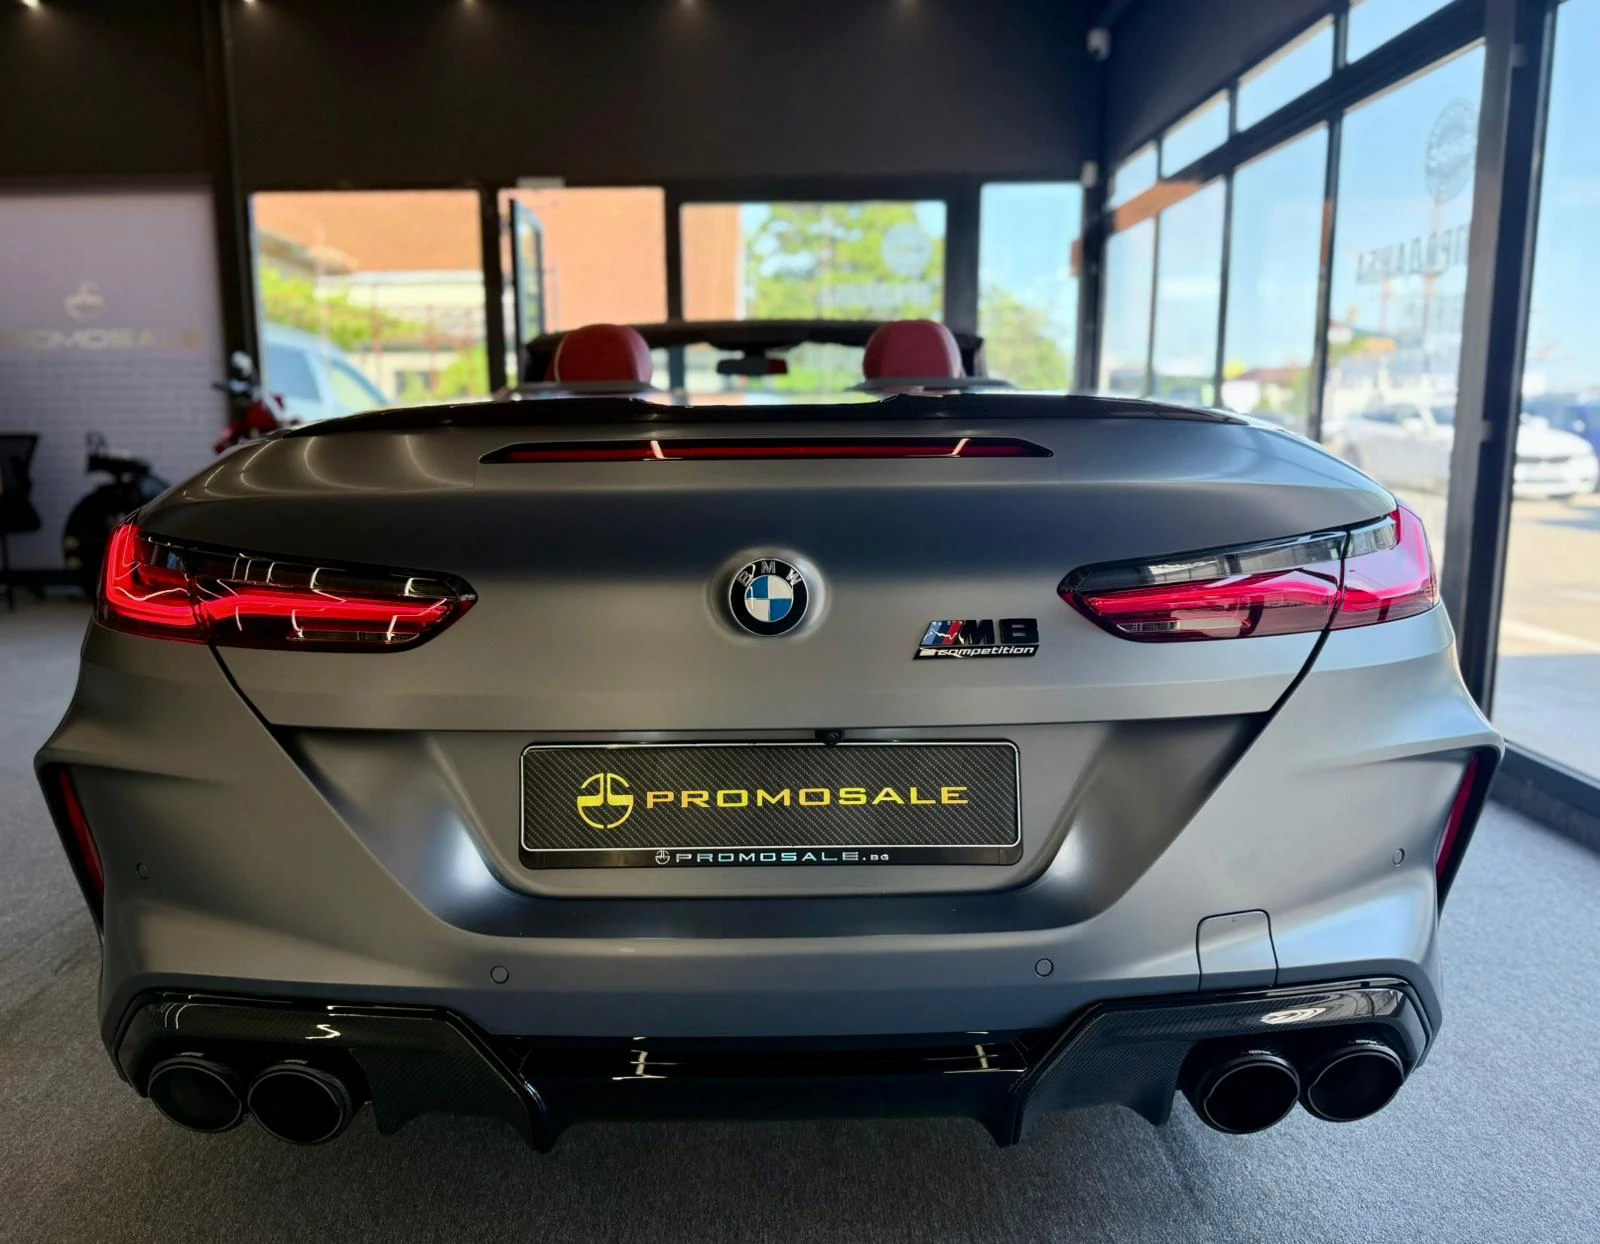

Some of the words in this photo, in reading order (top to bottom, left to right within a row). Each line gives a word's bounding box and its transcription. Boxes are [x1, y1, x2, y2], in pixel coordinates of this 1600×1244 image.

[737, 560, 802, 587] BMW
[938, 645, 1035, 657] competition
[646, 786, 969, 809] PROMOSALE
